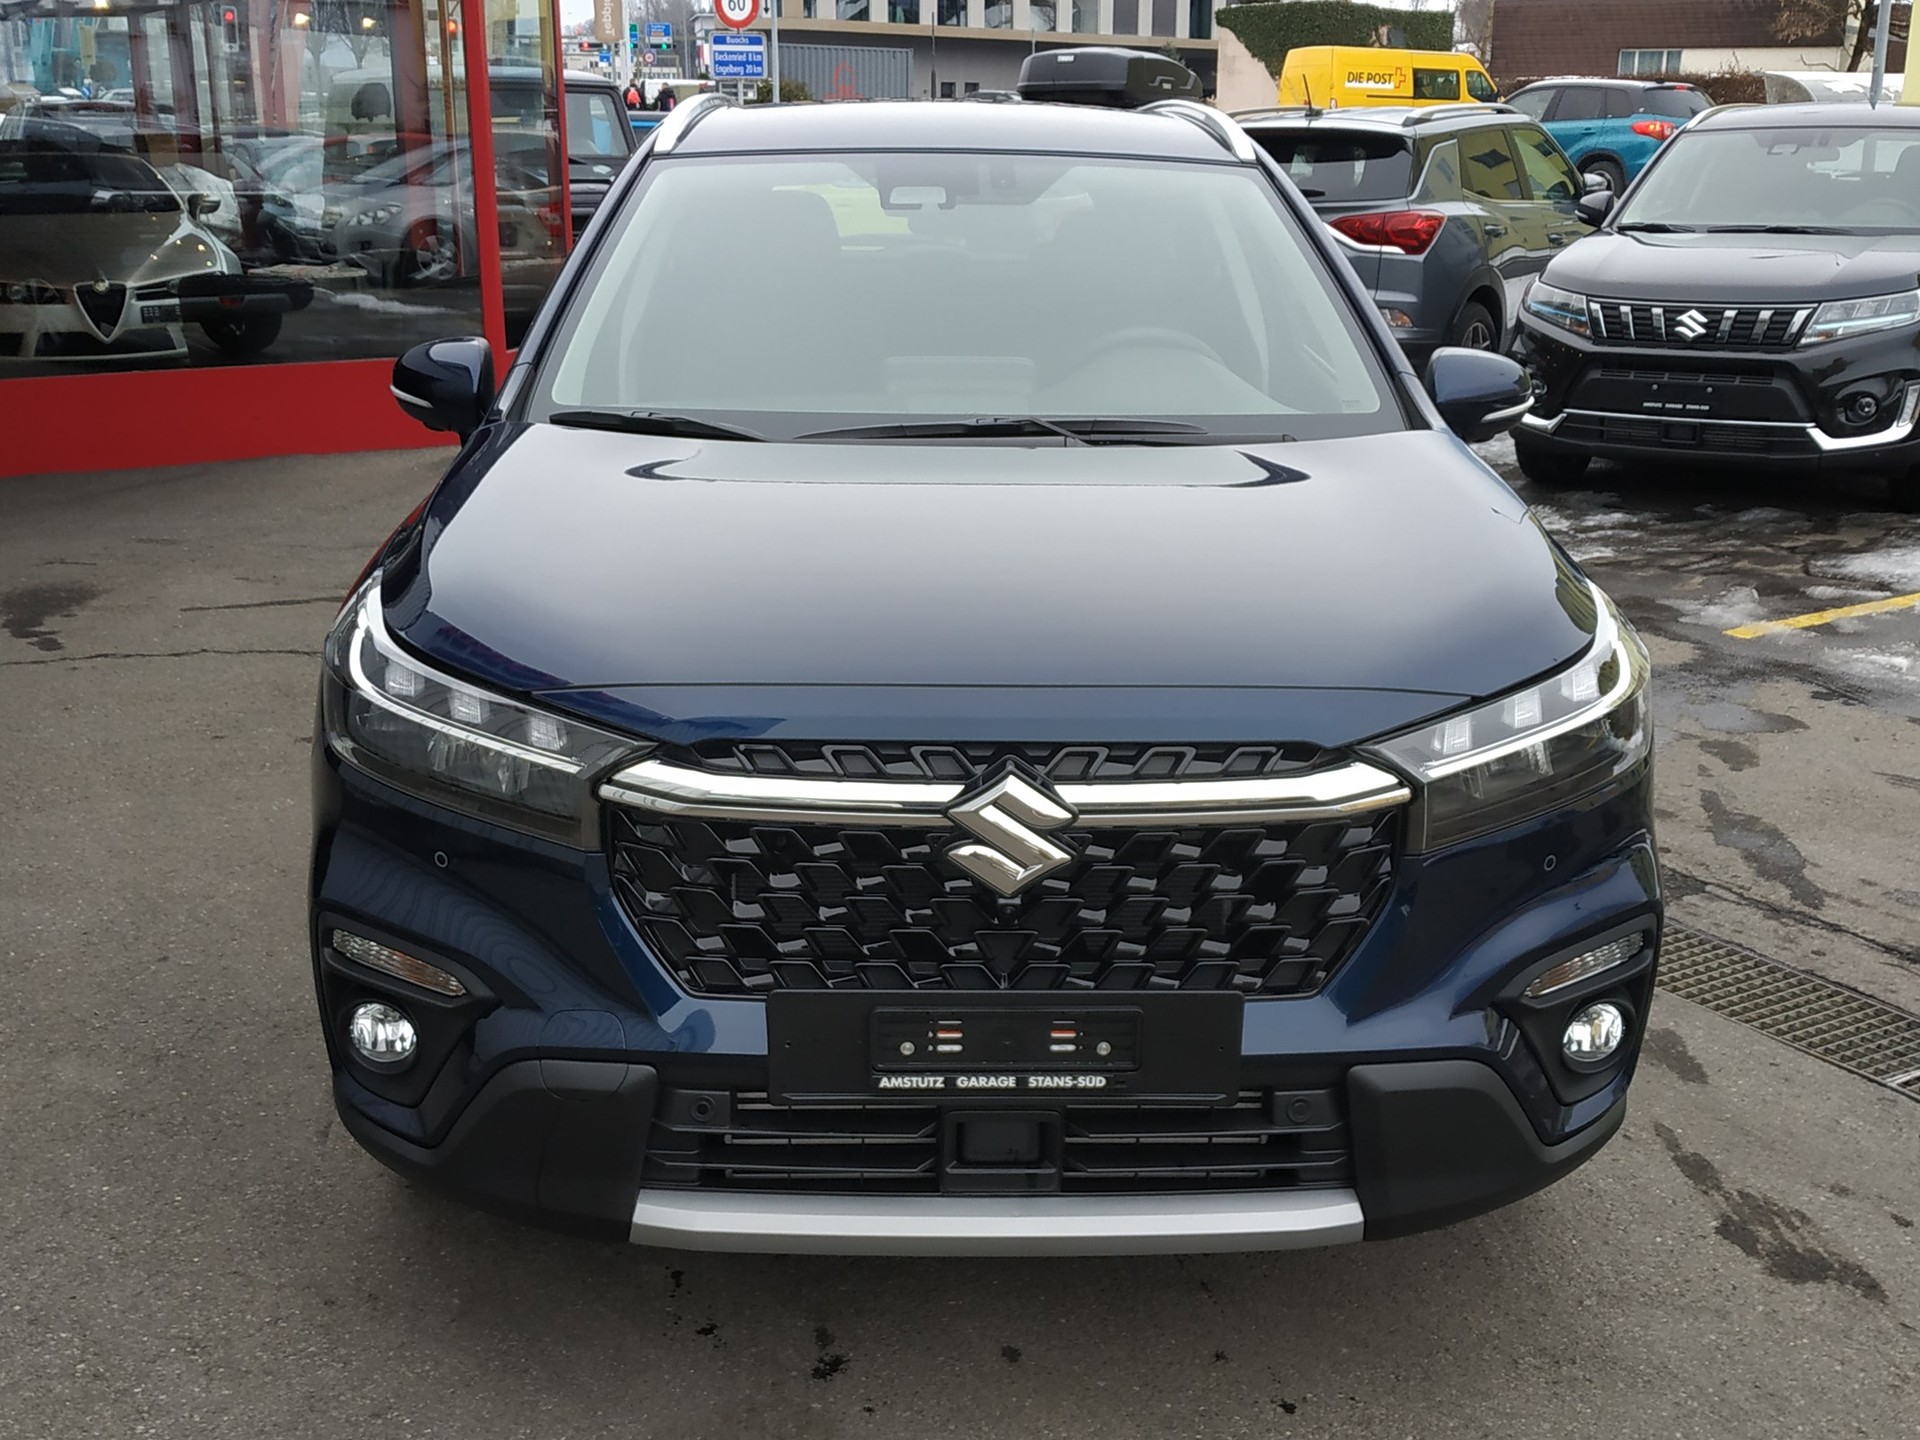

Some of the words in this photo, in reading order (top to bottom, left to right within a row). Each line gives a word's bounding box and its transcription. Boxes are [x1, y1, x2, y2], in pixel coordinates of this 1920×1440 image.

[715, 52, 746, 61] Beckenried
[754, 53, 762, 61] km
[716, 64, 744, 75] Engelberg
[754, 65, 763, 73] km
[1347, 72, 1364, 83] DIE
[1366, 73, 1394, 84] POST
[879, 1076, 945, 1088] AMSTUTZ
[956, 1076, 1016, 1088] GARAGE
[1028, 1075, 1107, 1088] STANS-SÜD
